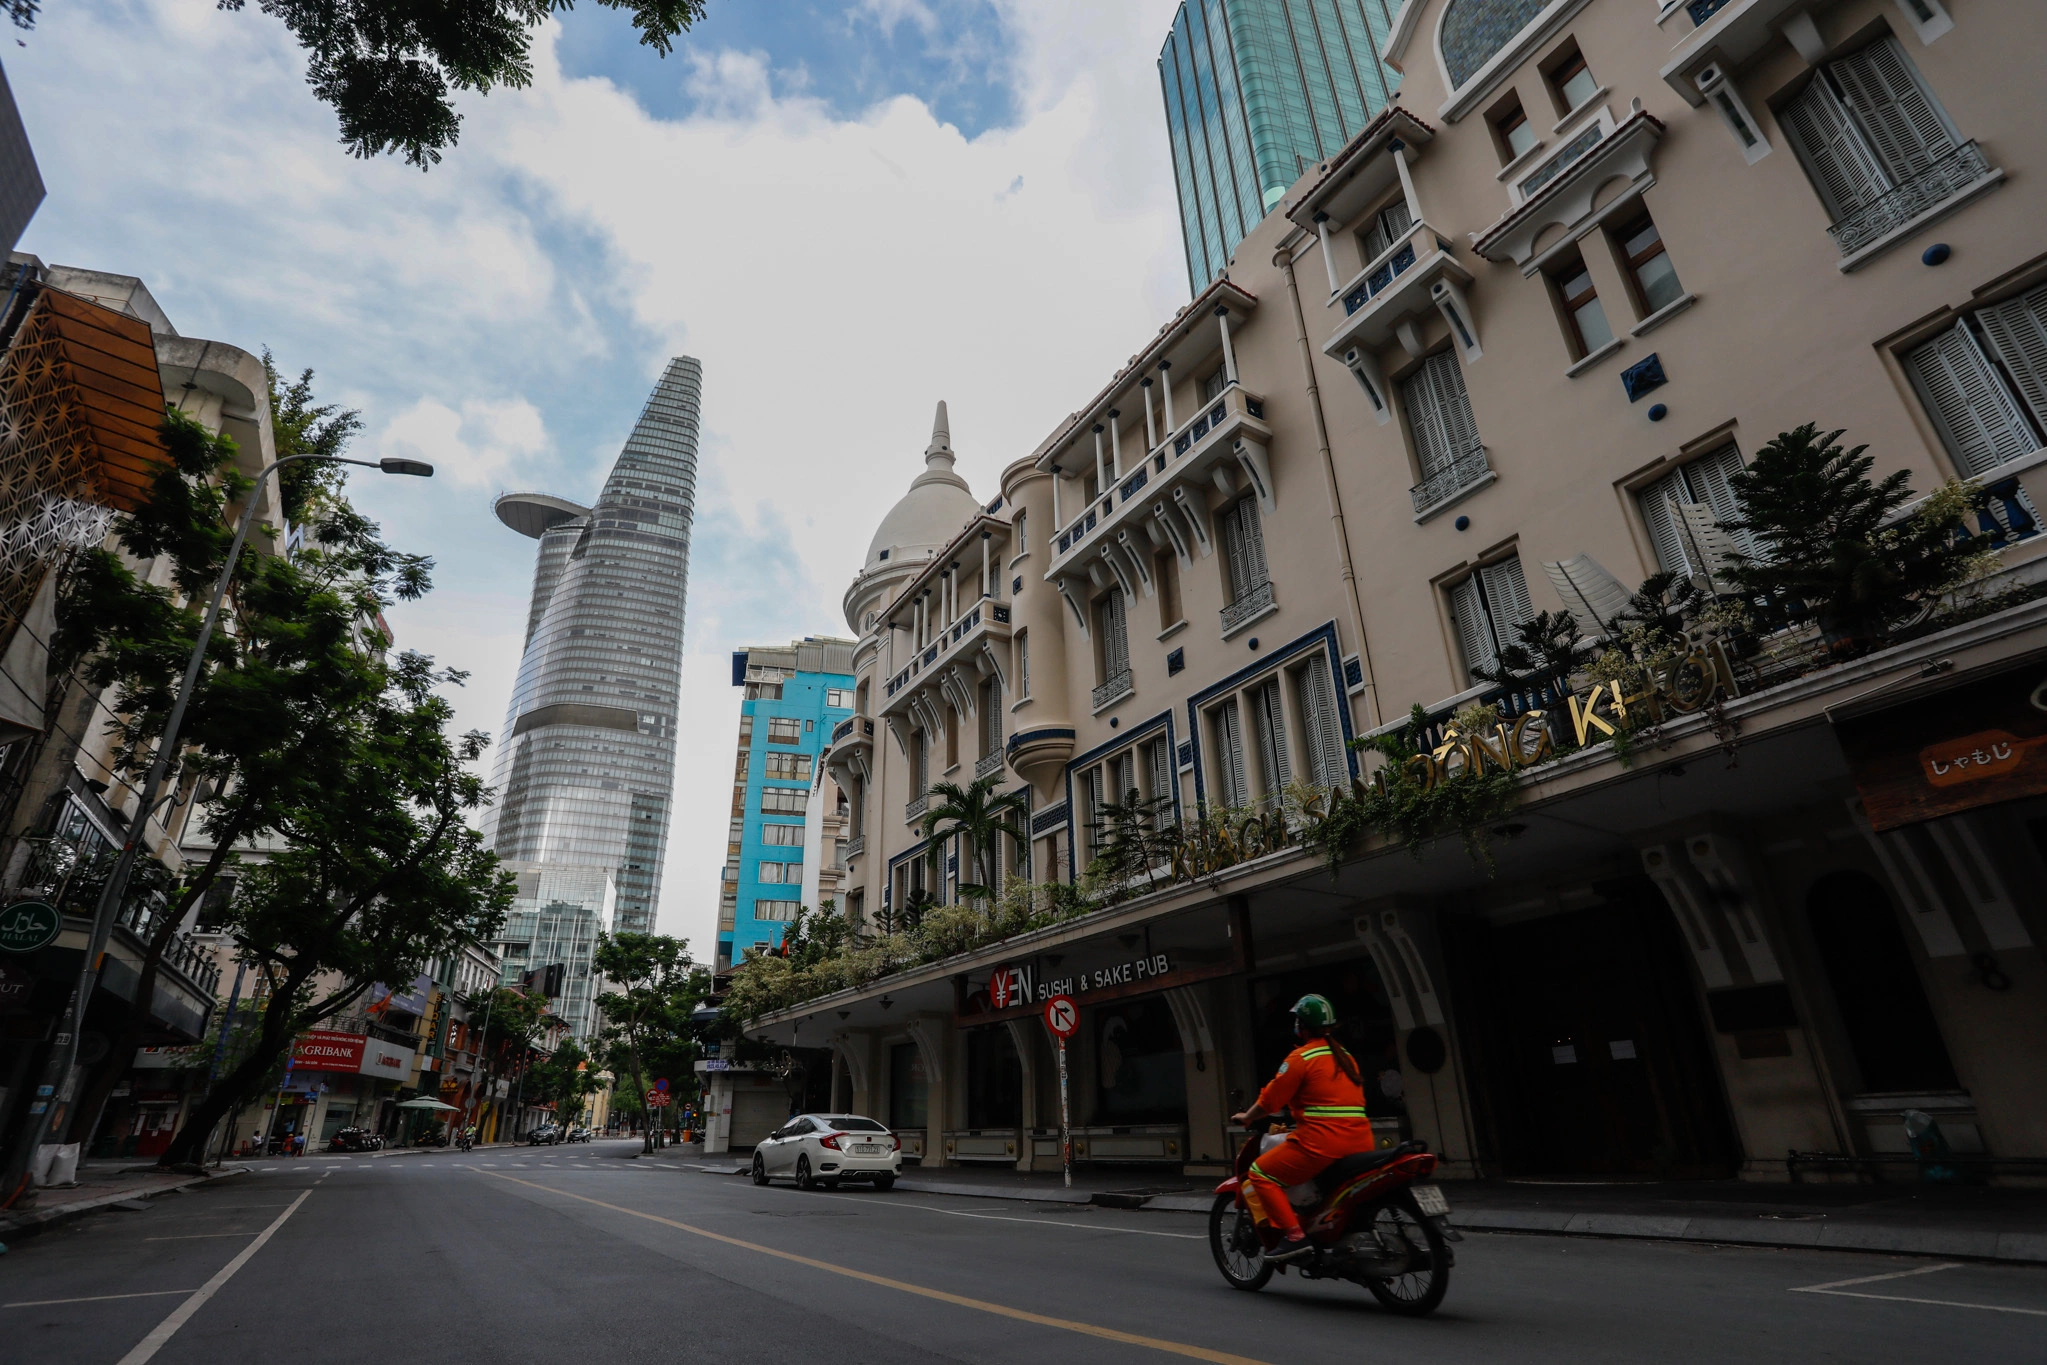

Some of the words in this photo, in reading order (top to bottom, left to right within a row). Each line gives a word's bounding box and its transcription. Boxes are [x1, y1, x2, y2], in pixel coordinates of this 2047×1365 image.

[1931, 742, 2013, 776] しゃもじ
[1, 912, 48, 934] حلال
[1, 932, 40, 942] HALAL
[1038, 977, 1074, 1001] SUSHI
[1080, 974, 1089, 992] &
[1095, 963, 1133, 988] SAKE
[1136, 953, 1169, 980] PUB
[295, 1045, 354, 1058] AGRIBANK
